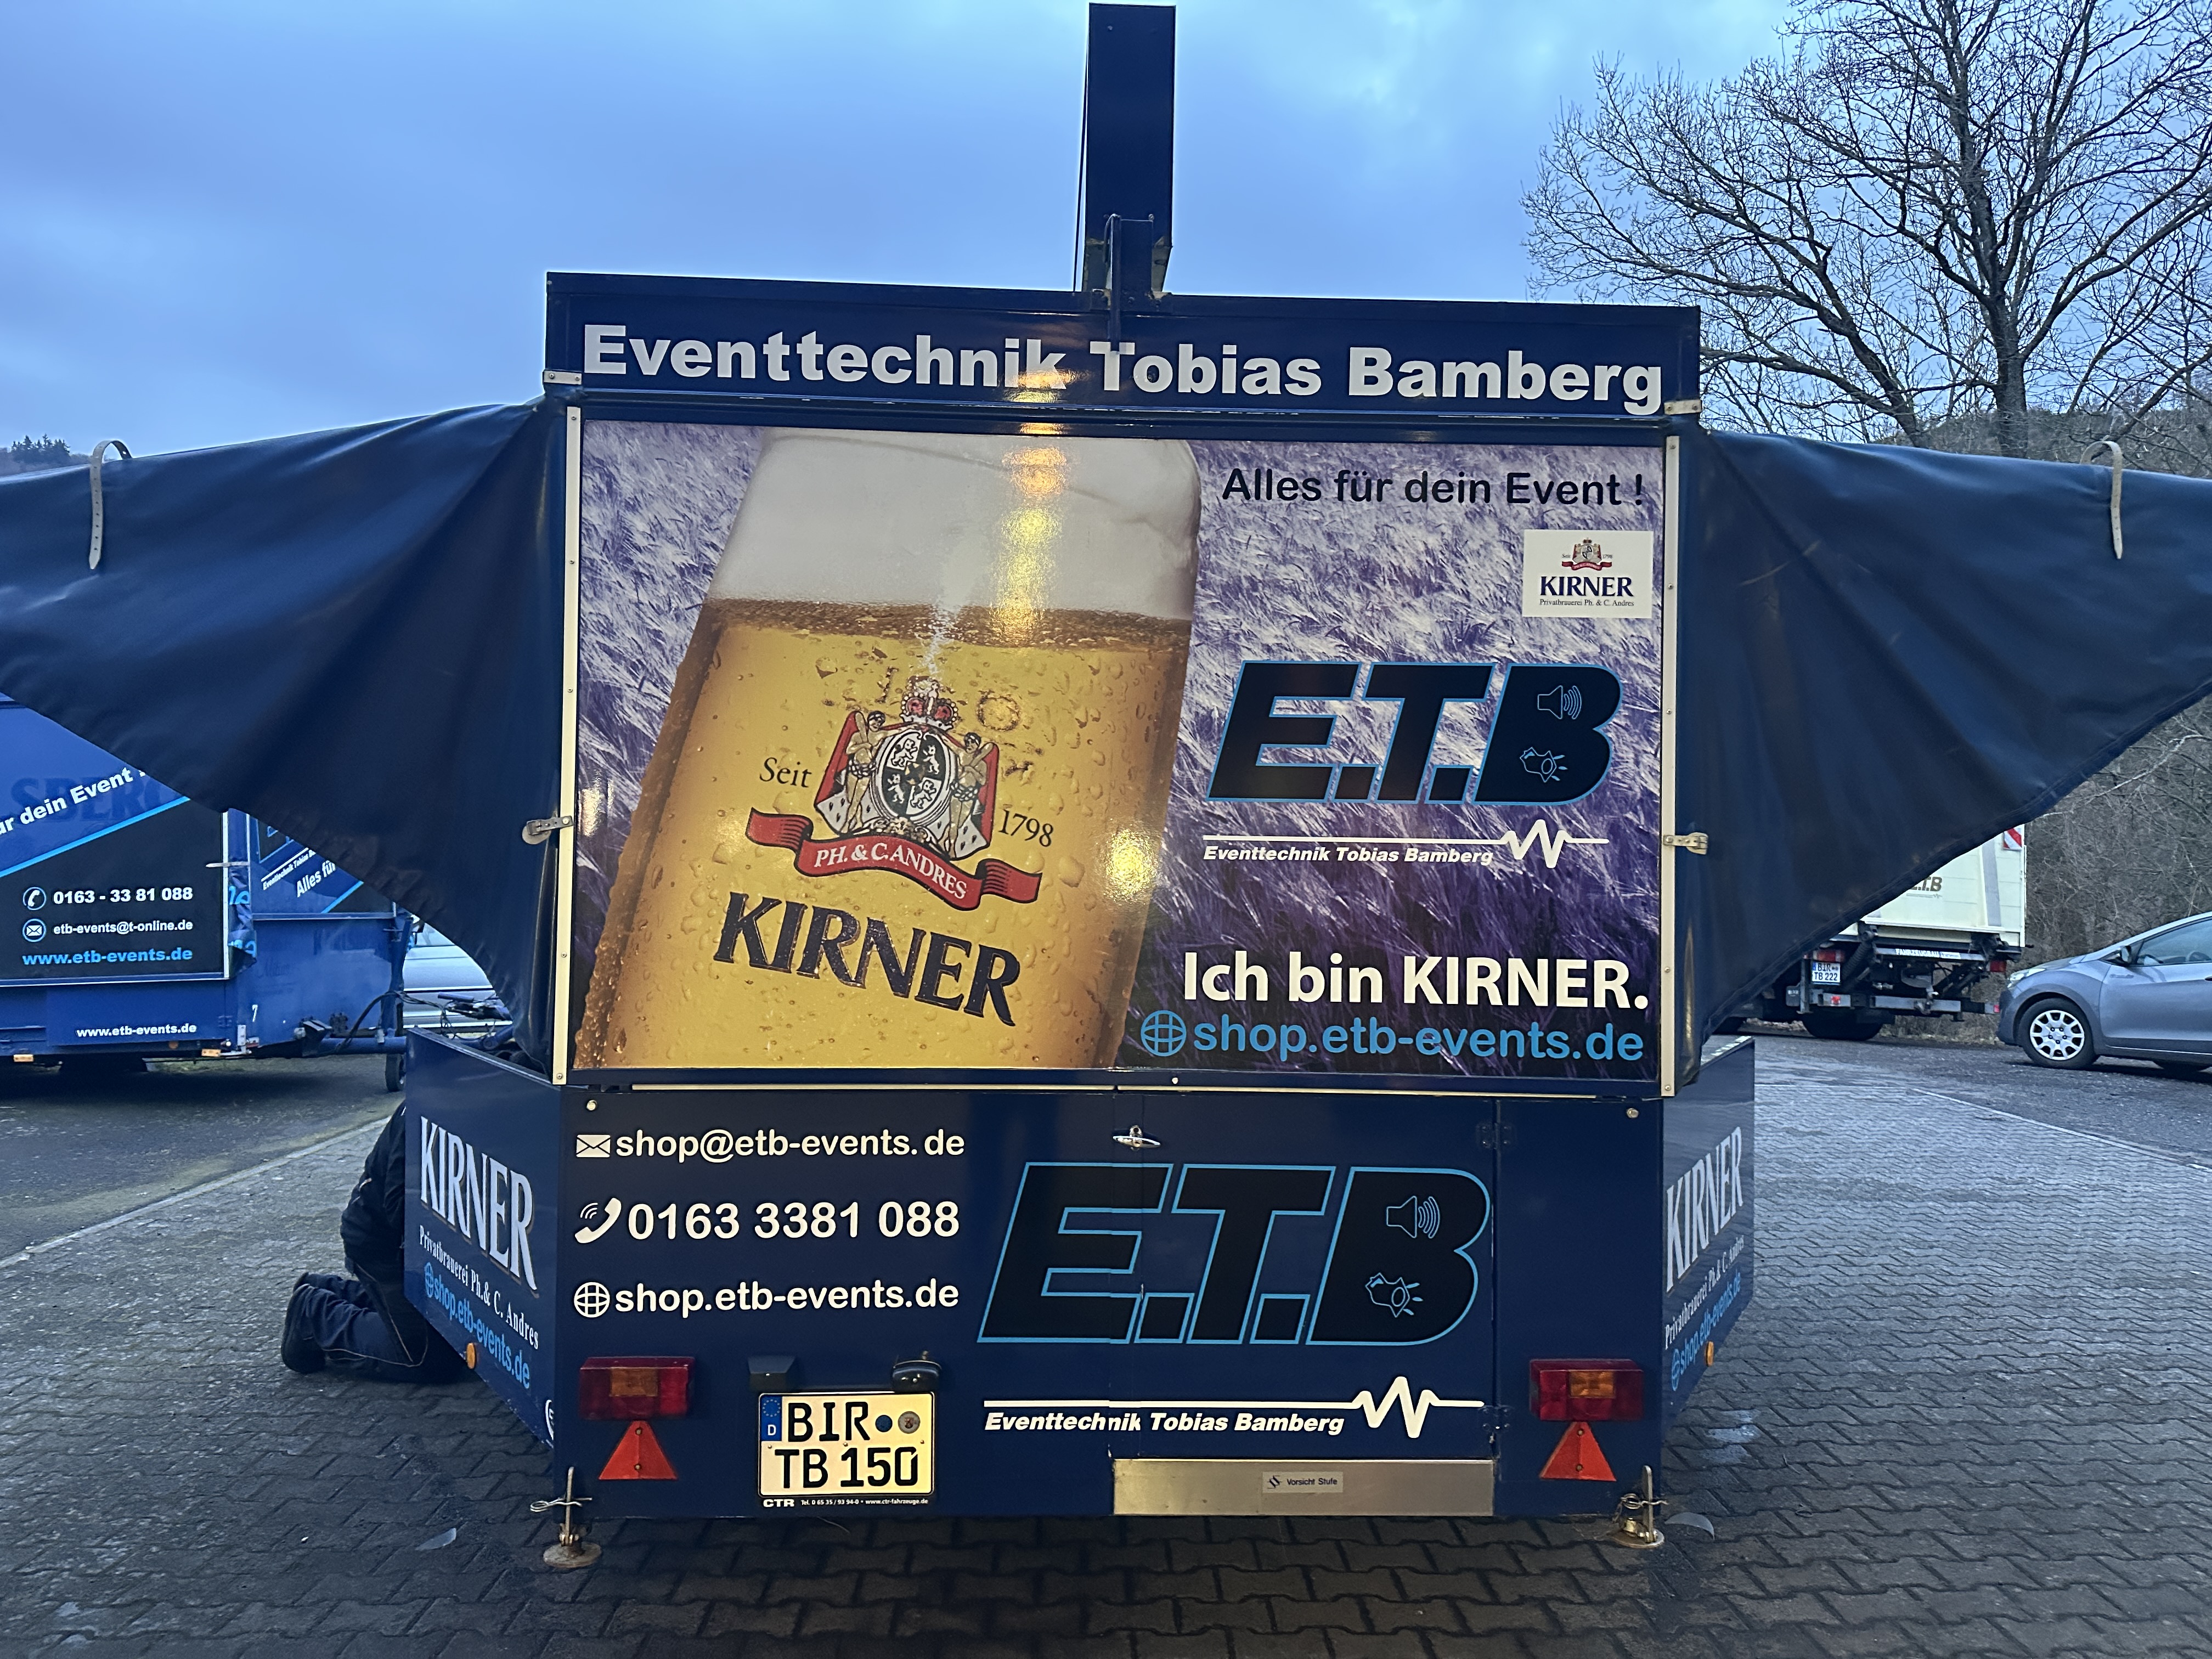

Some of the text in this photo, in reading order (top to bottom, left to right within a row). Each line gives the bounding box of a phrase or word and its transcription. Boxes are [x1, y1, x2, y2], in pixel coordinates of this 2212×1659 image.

[584, 324, 1662, 415] Eventtechnik Tobias Bamberg
[1222, 468, 1643, 506] Alles für dein Event !
[1540, 576, 1634, 597] KIRNER
[759, 757, 812, 789] Seit
[20, 798, 67, 824] dein
[70, 767, 133, 804] Event
[998, 809, 1054, 847] 1798
[1204, 845, 1493, 866] Eventtechnik Tobias Bamberg
[54, 890, 95, 905] 0163
[110, 889, 131, 903] 33
[136, 888, 155, 901] 81
[161, 887, 193, 901] 088
[297, 871, 321, 898] Alles
[53, 920, 193, 934] etb-events@t-online.de
[22, 947, 192, 965] www.etb-events.de
[713, 891, 1021, 1026] KIRNER
[1818, 963, 1831, 972] BIR
[1184, 951, 1649, 1009] Ich bin KIRNER.
[1814, 972, 1838, 981] TB 222
[76, 1023, 196, 1037] www.etb-events.de
[1194, 1014, 1643, 1062] shop.etb-events.de
[420, 1116, 538, 1291] KIRNER
[628, 1201, 959, 1239] 0163 3381 088
[1666, 1125, 1743, 1294] KIRNER
[420, 1224, 468, 1286] Privatbrauerei
[506, 1302, 539, 1350] Andres
[616, 1279, 959, 1318] shop.etb-events.de
[433, 1274, 530, 1389] shop.etb-events.de
[1665, 1276, 1707, 1350] Privatbrauerei
[1680, 1267, 1741, 1375] shop.etb-events.de
[768, 1424, 777, 1436] D
[788, 1402, 870, 1442] BIR
[984, 1412, 1345, 1435] Eventtechnik Tobias Bamberg
[775, 1447, 918, 1489] TB 150
[763, 1499, 794, 1508] CTR
